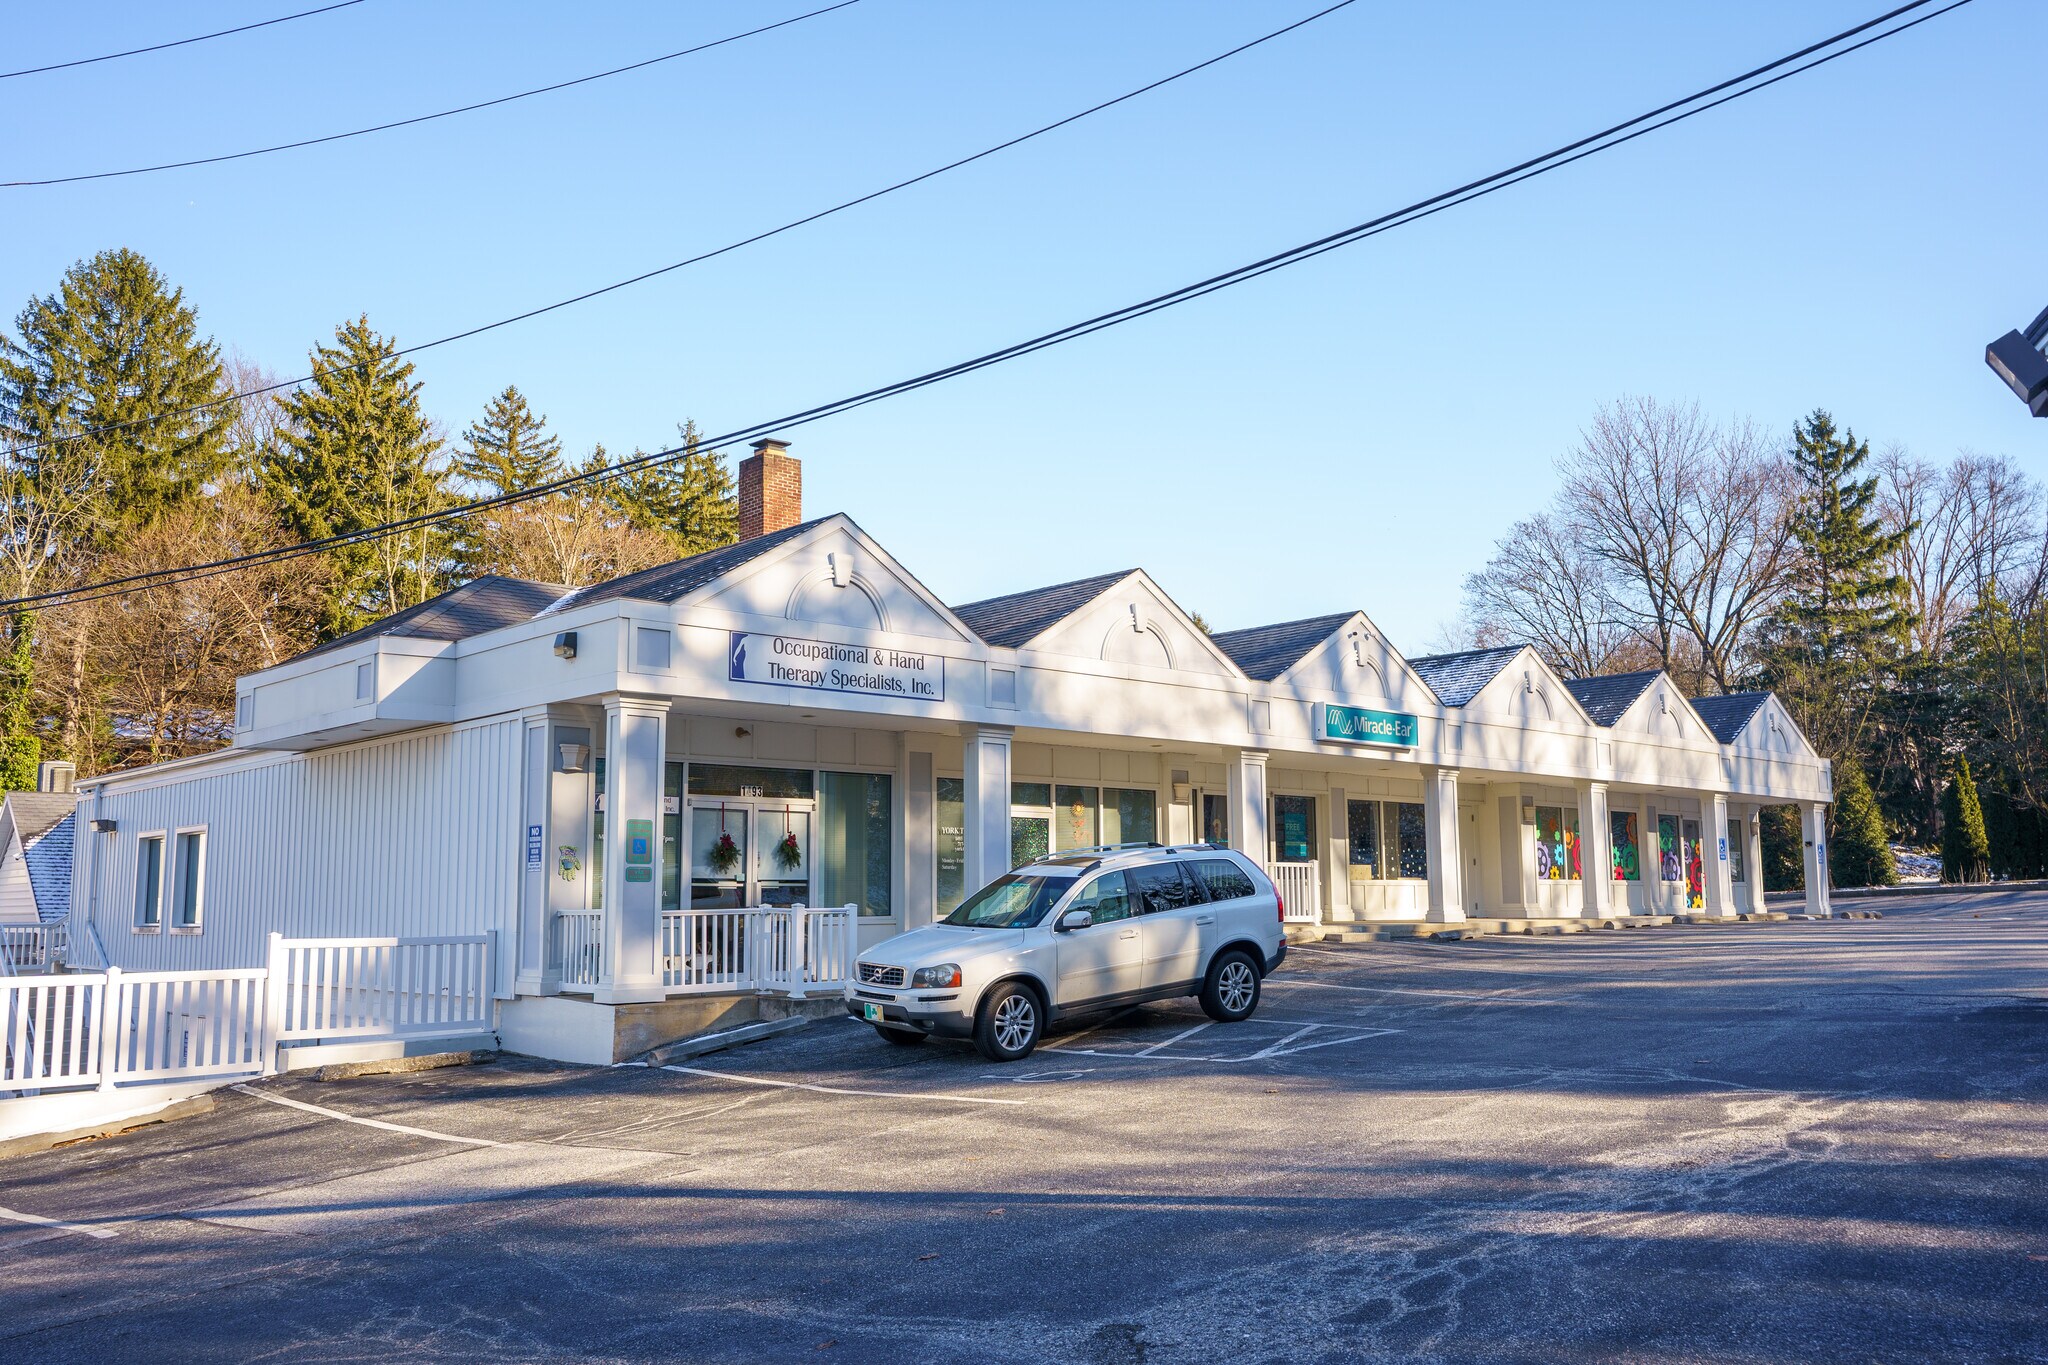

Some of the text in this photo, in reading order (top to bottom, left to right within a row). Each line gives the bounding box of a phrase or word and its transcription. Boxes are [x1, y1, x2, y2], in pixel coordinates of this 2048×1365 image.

[773, 638, 925, 671] Occupational & Hand
[768, 662, 935, 696] Therapy Specialists, Inc.
[531, 827, 540, 836] NO
